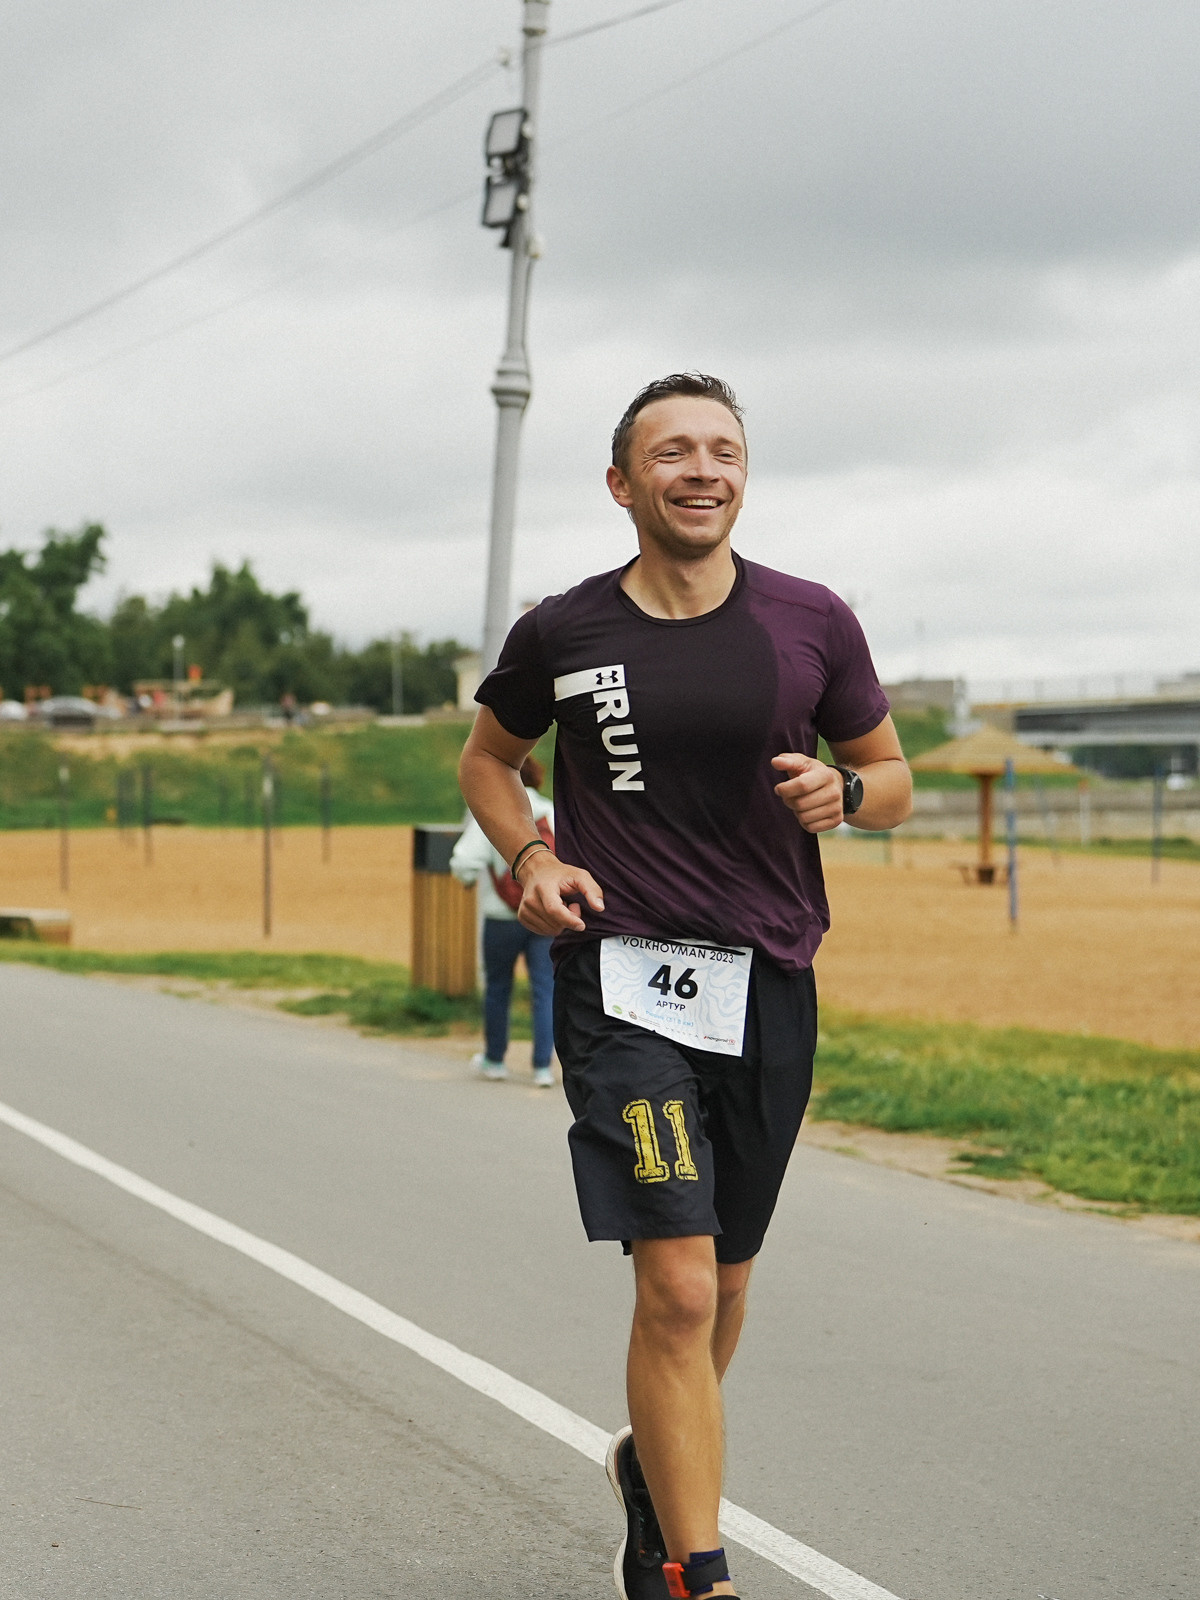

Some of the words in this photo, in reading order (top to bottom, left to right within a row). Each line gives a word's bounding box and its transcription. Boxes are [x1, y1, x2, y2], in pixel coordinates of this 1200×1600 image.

[592, 687, 645, 791] RUN
[621, 935, 706, 959] VOLKHOVMAN
[709, 951, 734, 963] 2023
[647, 964, 699, 1000] 46
[656, 1000, 686, 1011] АРТУР
[621, 1098, 699, 1184] 11
